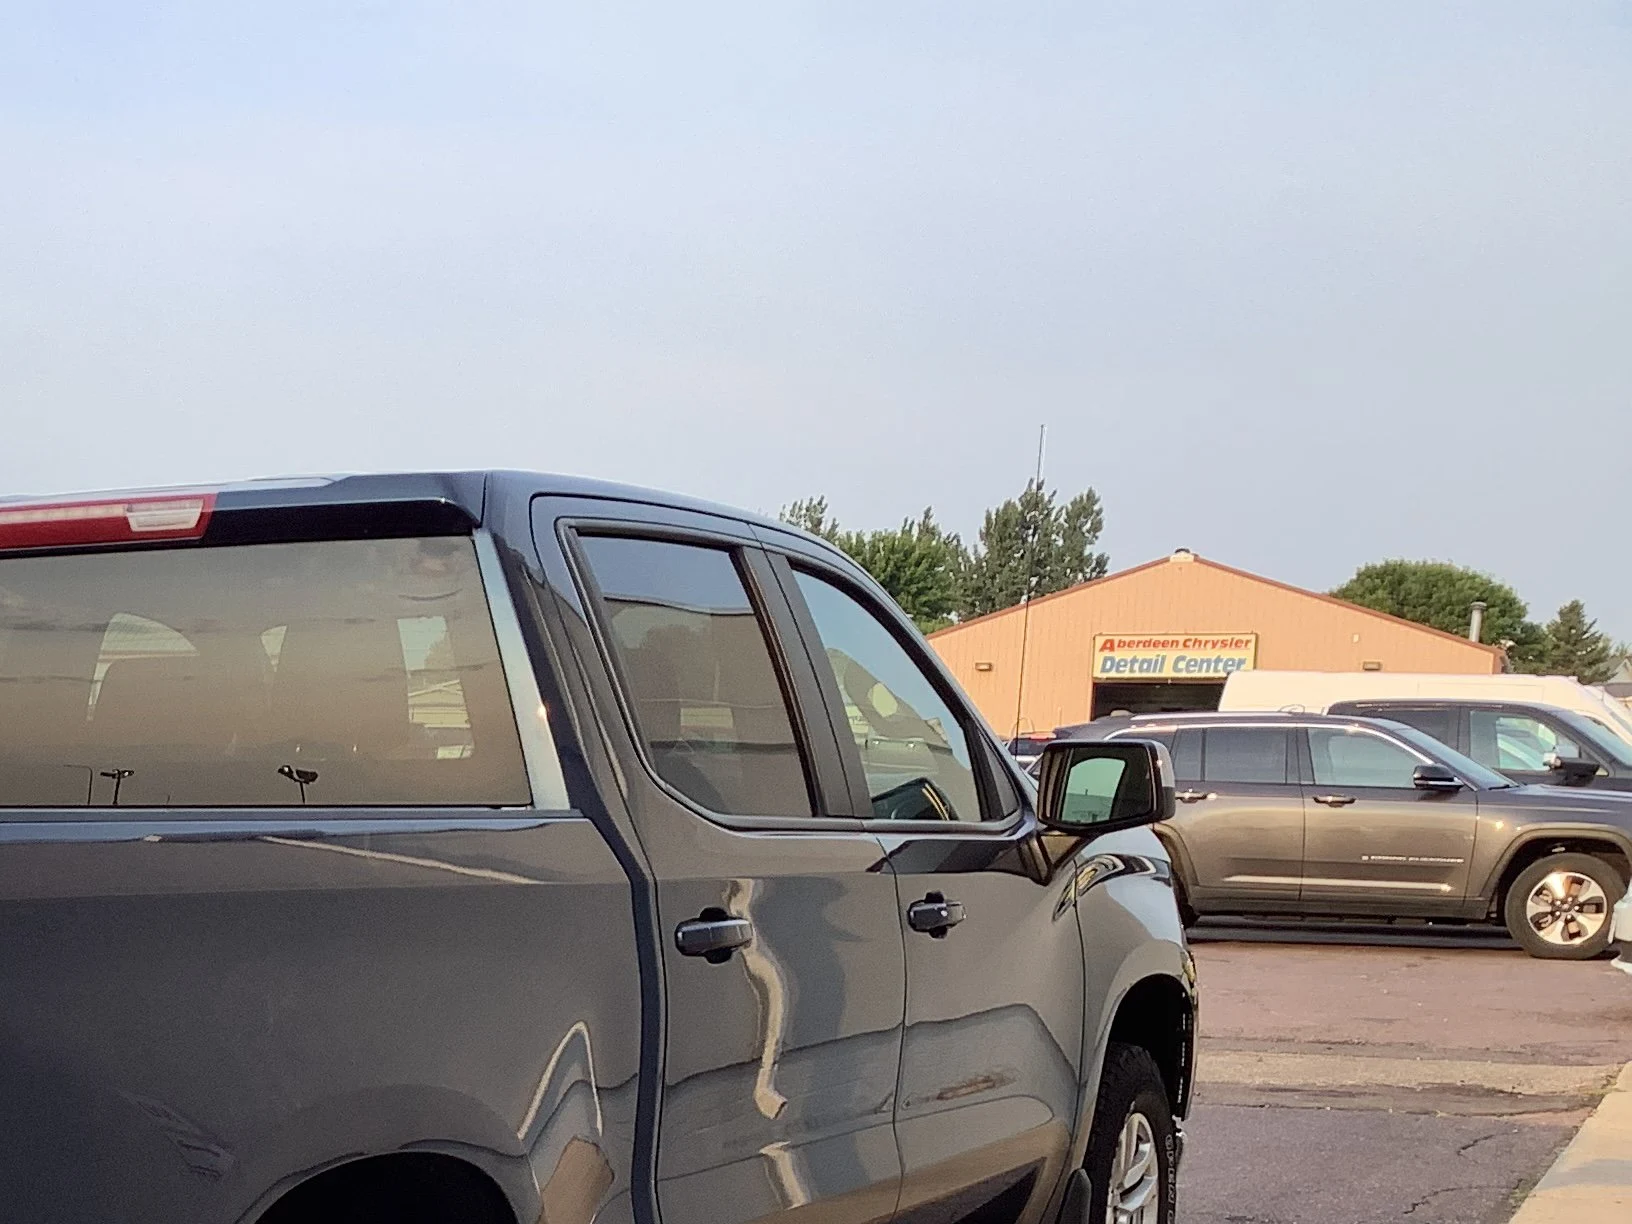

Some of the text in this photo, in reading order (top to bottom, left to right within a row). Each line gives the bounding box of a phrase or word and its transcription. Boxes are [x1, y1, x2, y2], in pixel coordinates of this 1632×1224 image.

[1099, 638, 1252, 652] Aberdeen Chrysler
[1100, 654, 1247, 674] Detail Center
